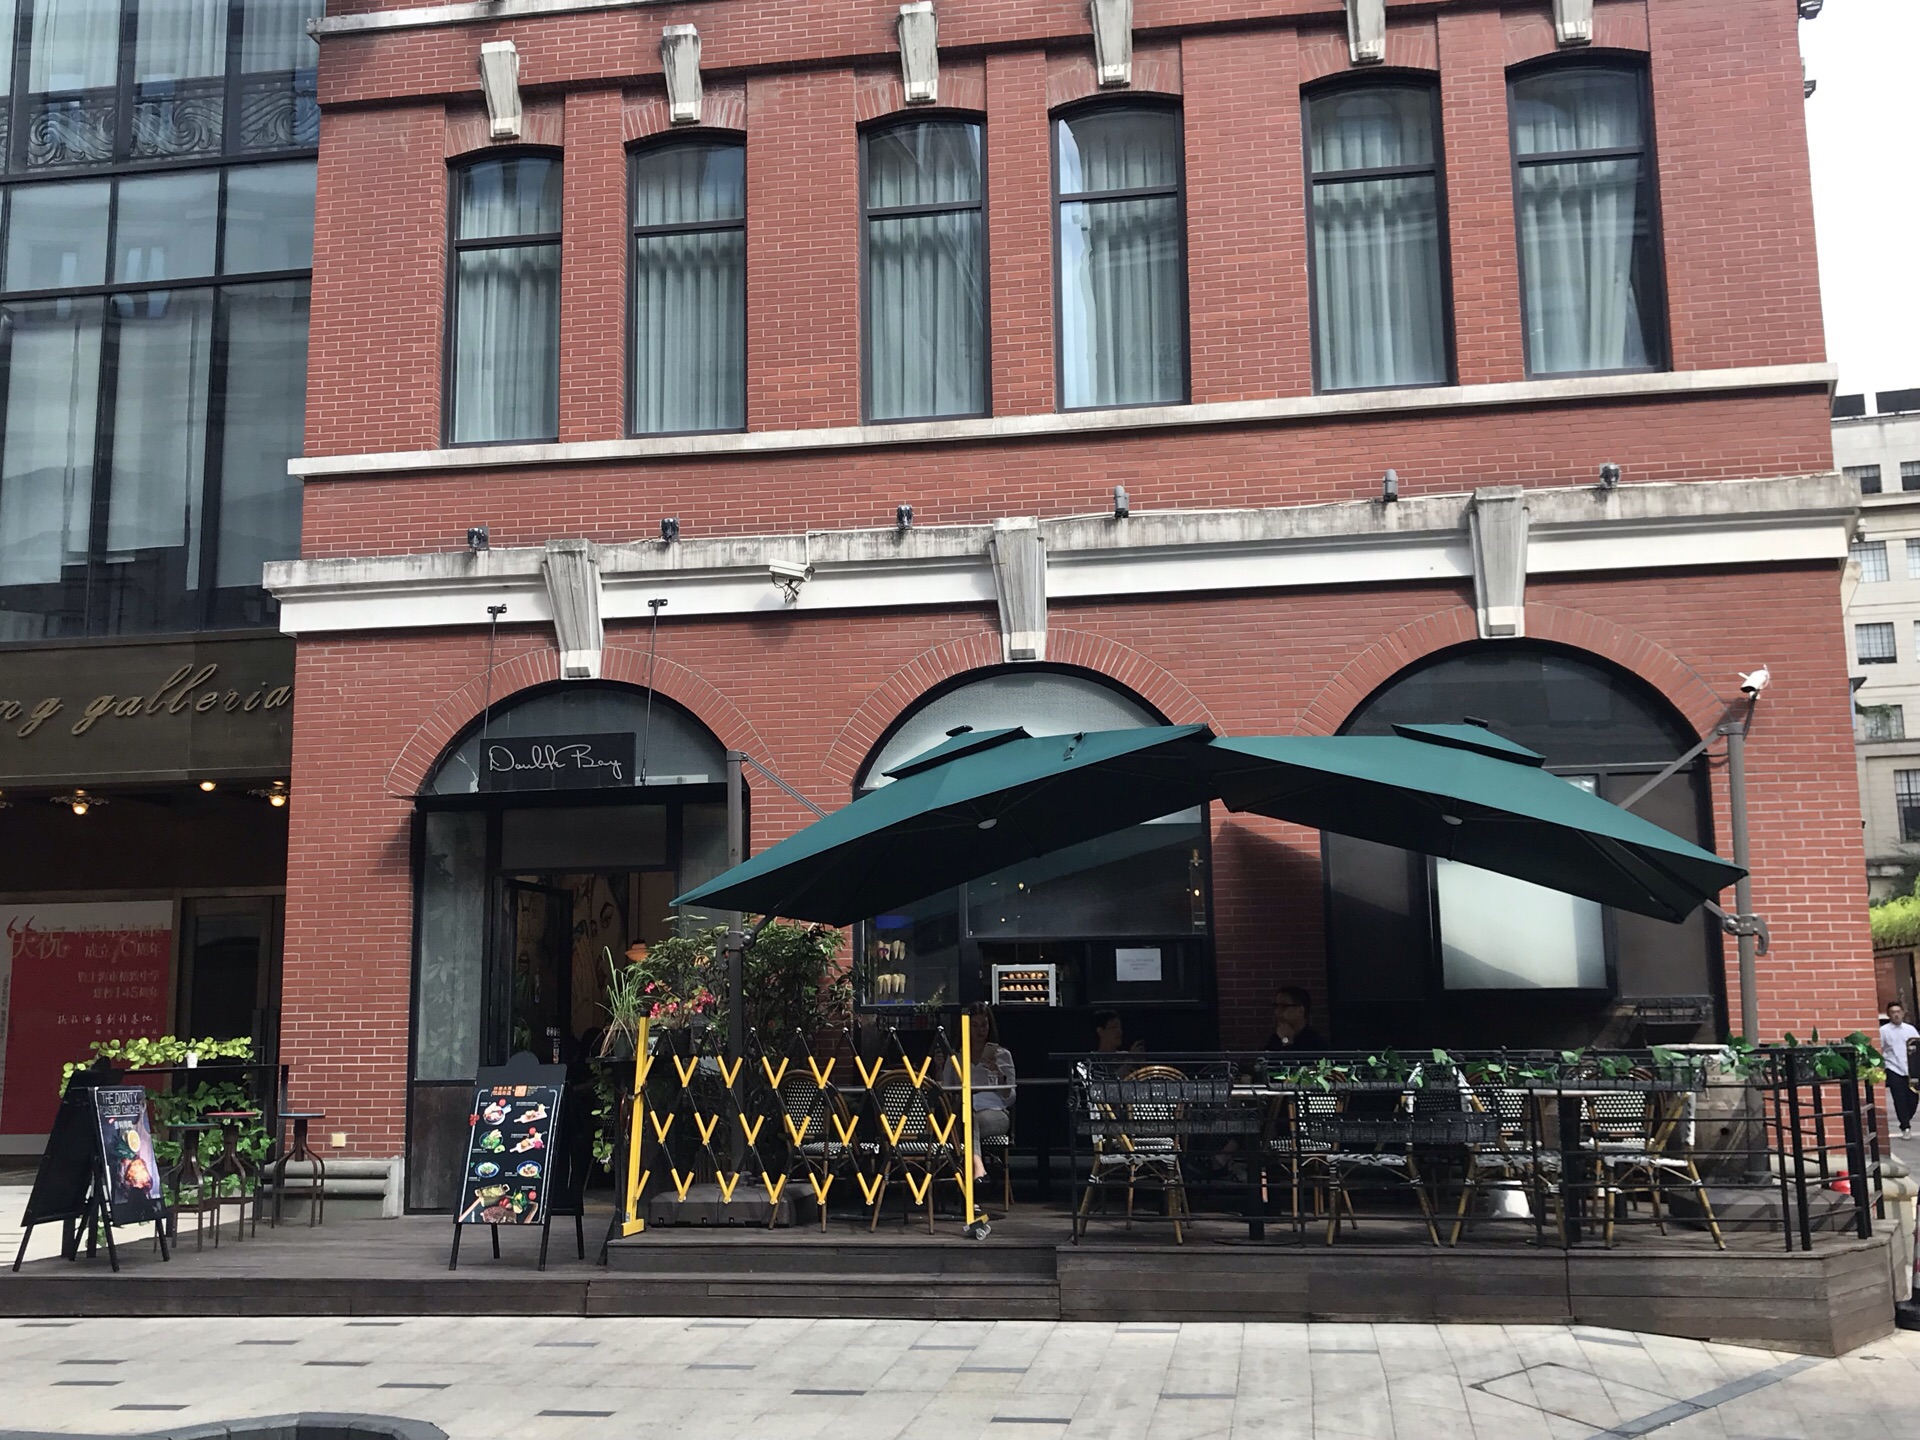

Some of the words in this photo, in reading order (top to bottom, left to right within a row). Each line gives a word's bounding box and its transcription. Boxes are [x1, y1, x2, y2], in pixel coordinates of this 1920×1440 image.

[71, 663, 292, 736] galleria
[489, 744, 565, 772] Double
[554, 743, 623, 780] Bay
[101, 1092, 114, 1105] THE
